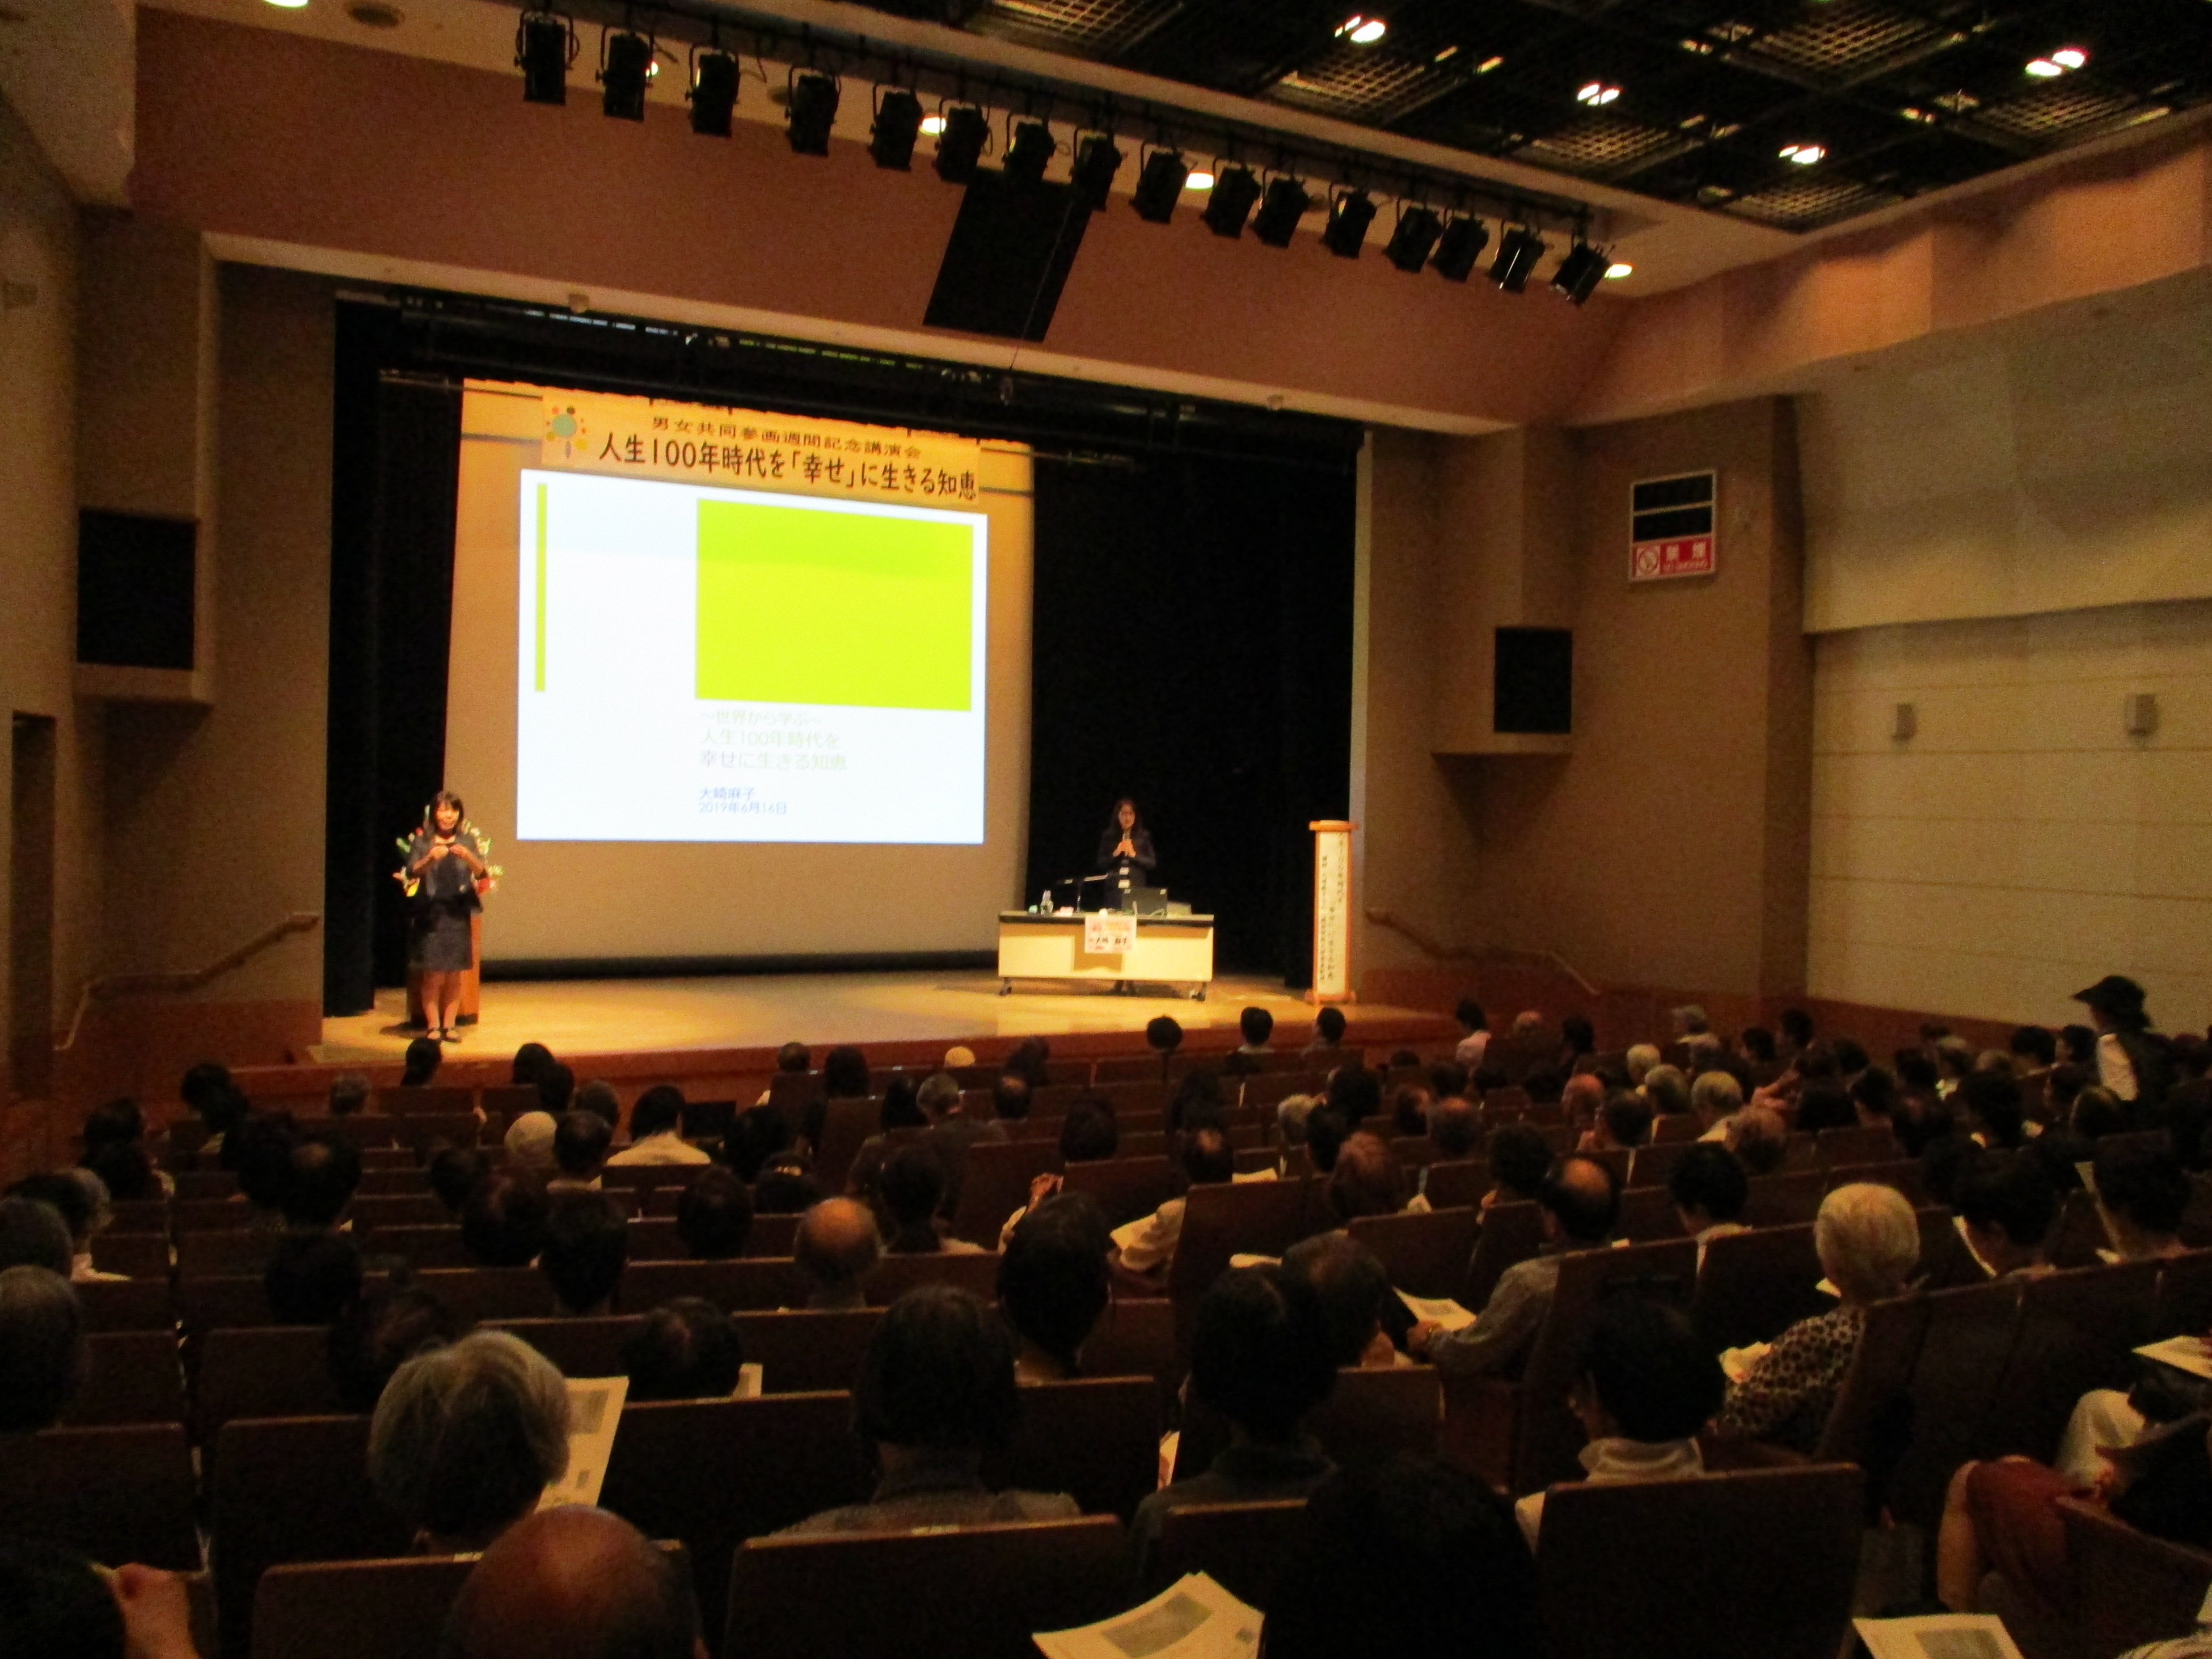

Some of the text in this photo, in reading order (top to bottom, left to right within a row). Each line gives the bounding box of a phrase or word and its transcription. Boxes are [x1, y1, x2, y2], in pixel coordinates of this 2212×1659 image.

[600, 432, 976, 500] 人生100年時代を「幸せ」に生きる知恵
[699, 801, 787, 814] 2019年6月16日
